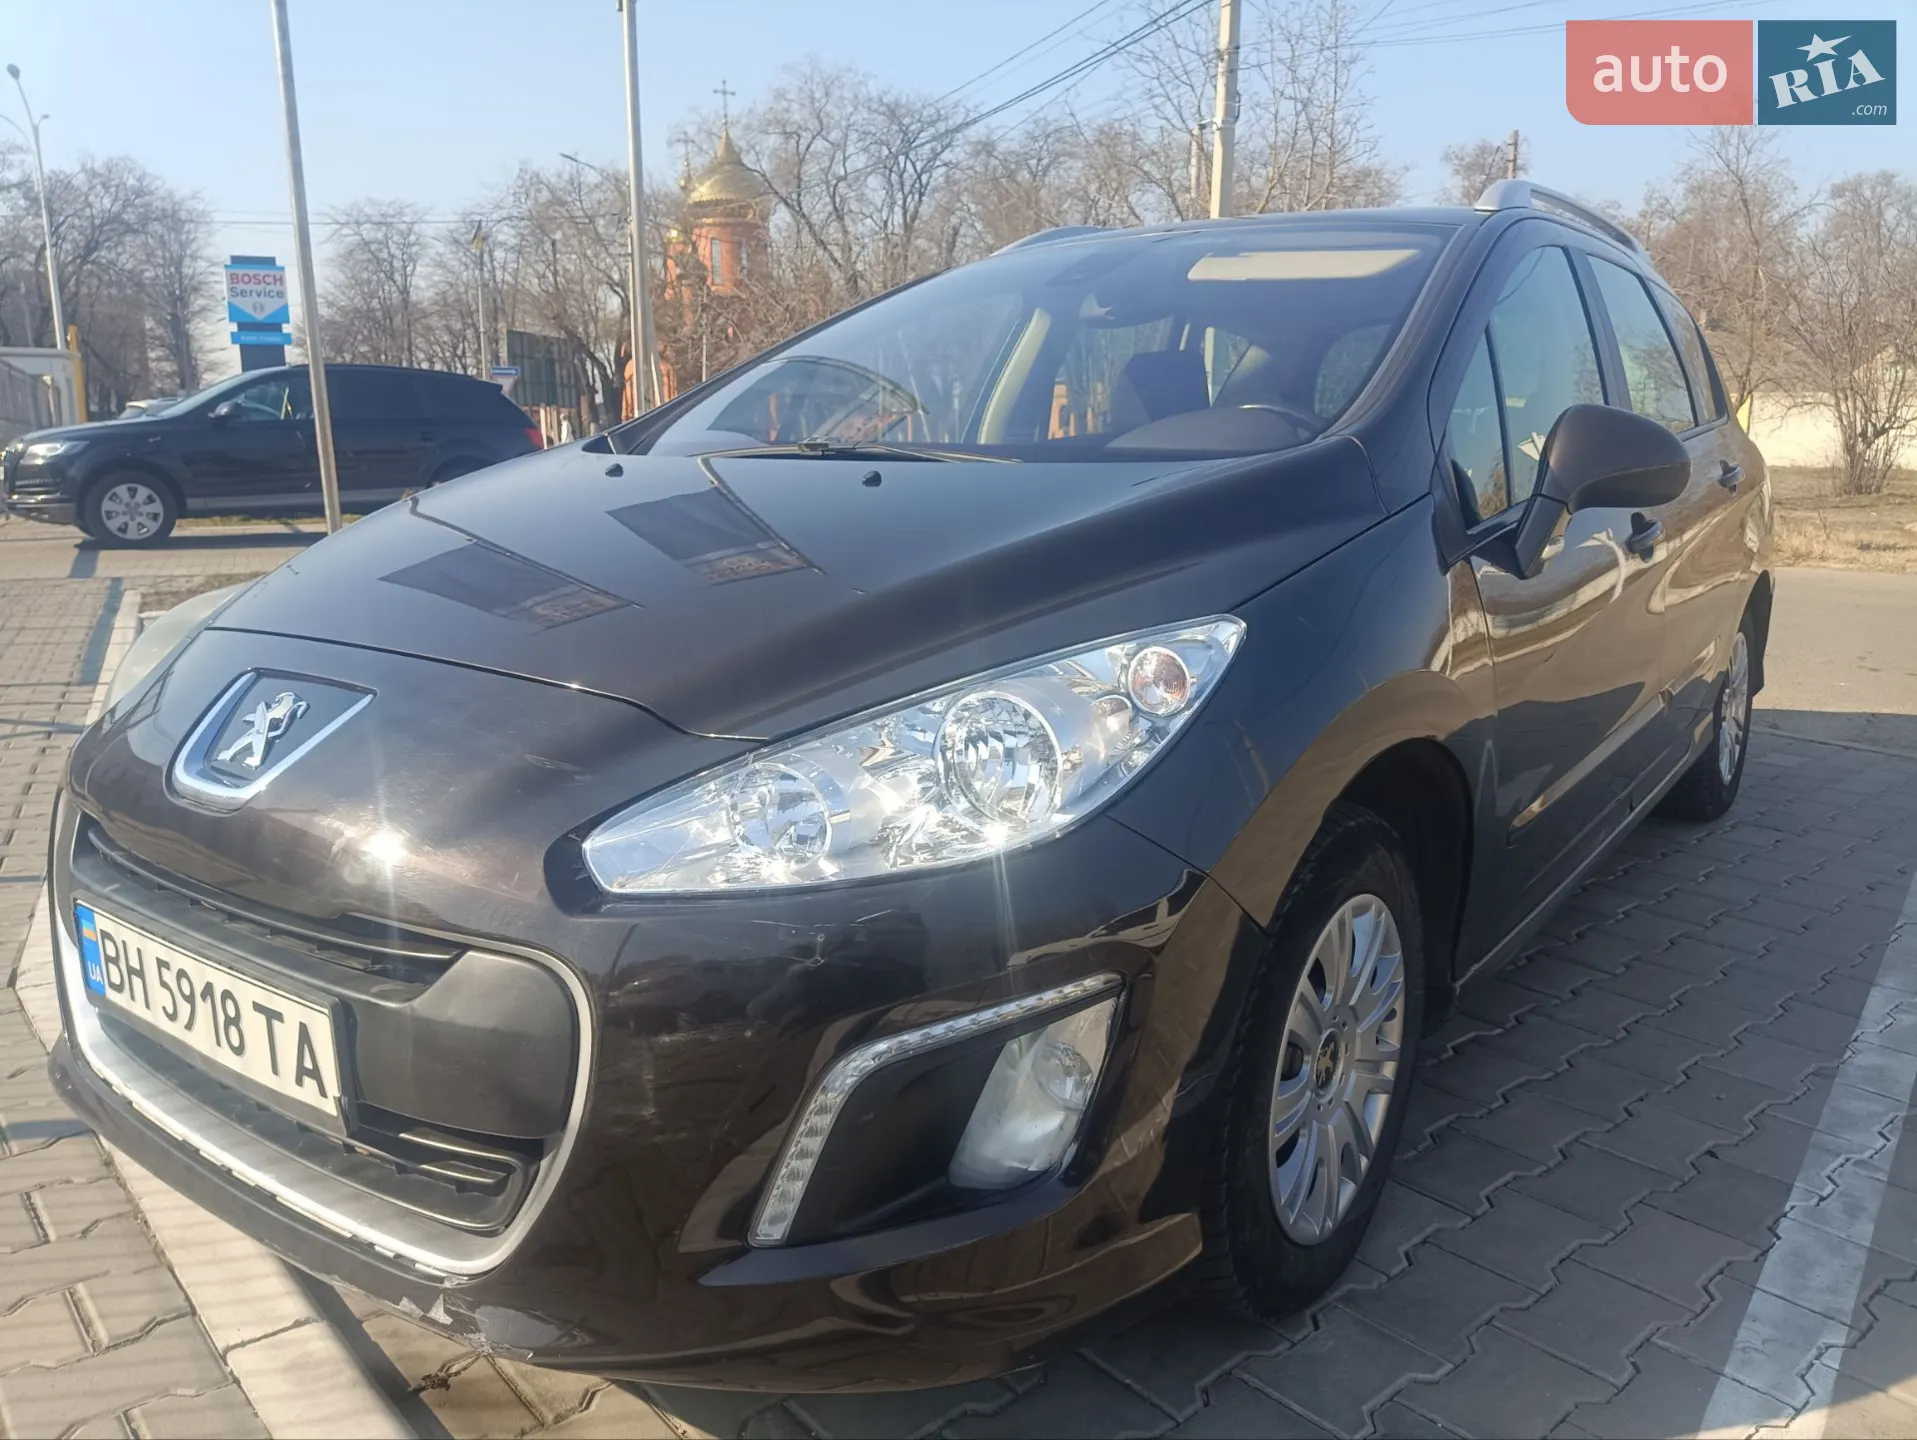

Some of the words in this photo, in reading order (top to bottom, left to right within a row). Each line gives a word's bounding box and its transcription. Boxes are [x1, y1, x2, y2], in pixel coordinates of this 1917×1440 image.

[229, 273, 284, 286] BOSCH
[230, 286, 285, 299] Service
[87, 960, 104, 985] UA
[100, 929, 151, 1011] BH
[155, 956, 246, 1057] 5918
[252, 1001, 329, 1099] TA
